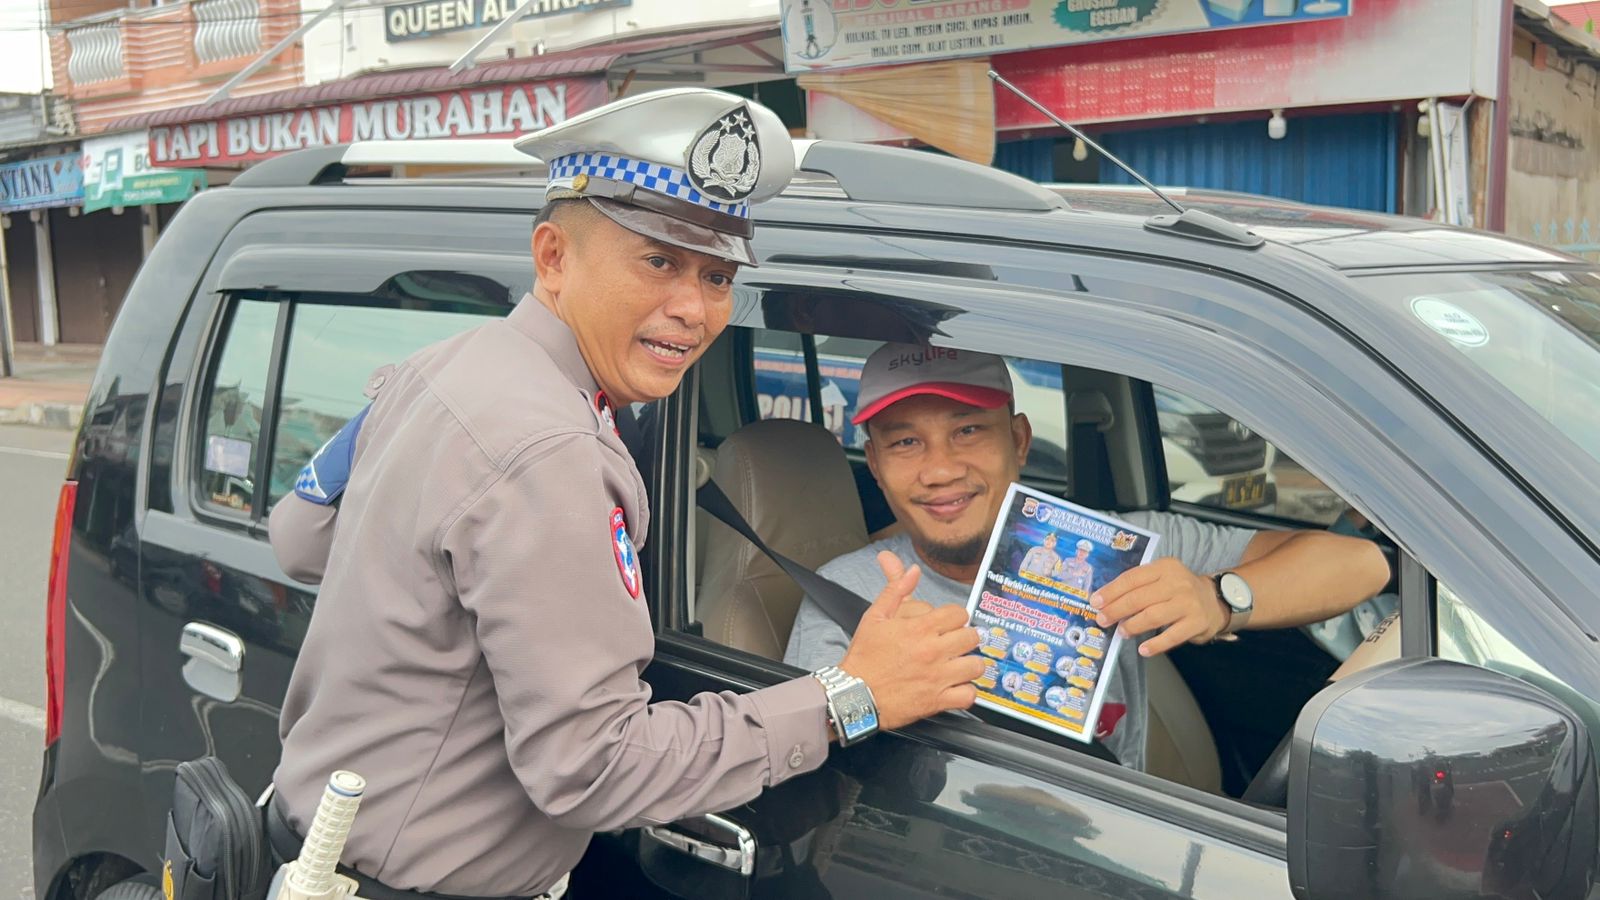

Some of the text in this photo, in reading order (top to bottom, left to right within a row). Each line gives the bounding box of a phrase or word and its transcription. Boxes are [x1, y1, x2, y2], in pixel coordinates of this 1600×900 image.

[389, 0, 475, 36] QUEEN
[914, 24, 942, 36] MESIN
[972, 17, 998, 30] KIPAS
[152, 83, 567, 162] TAPI BUKAN MURAHAN
[1053, 507, 1114, 537] SATLANTAS
[981, 590, 1015, 610] Operasi
[979, 600, 1037, 628] Singgalang
[1039, 620, 1065, 636] 2026
